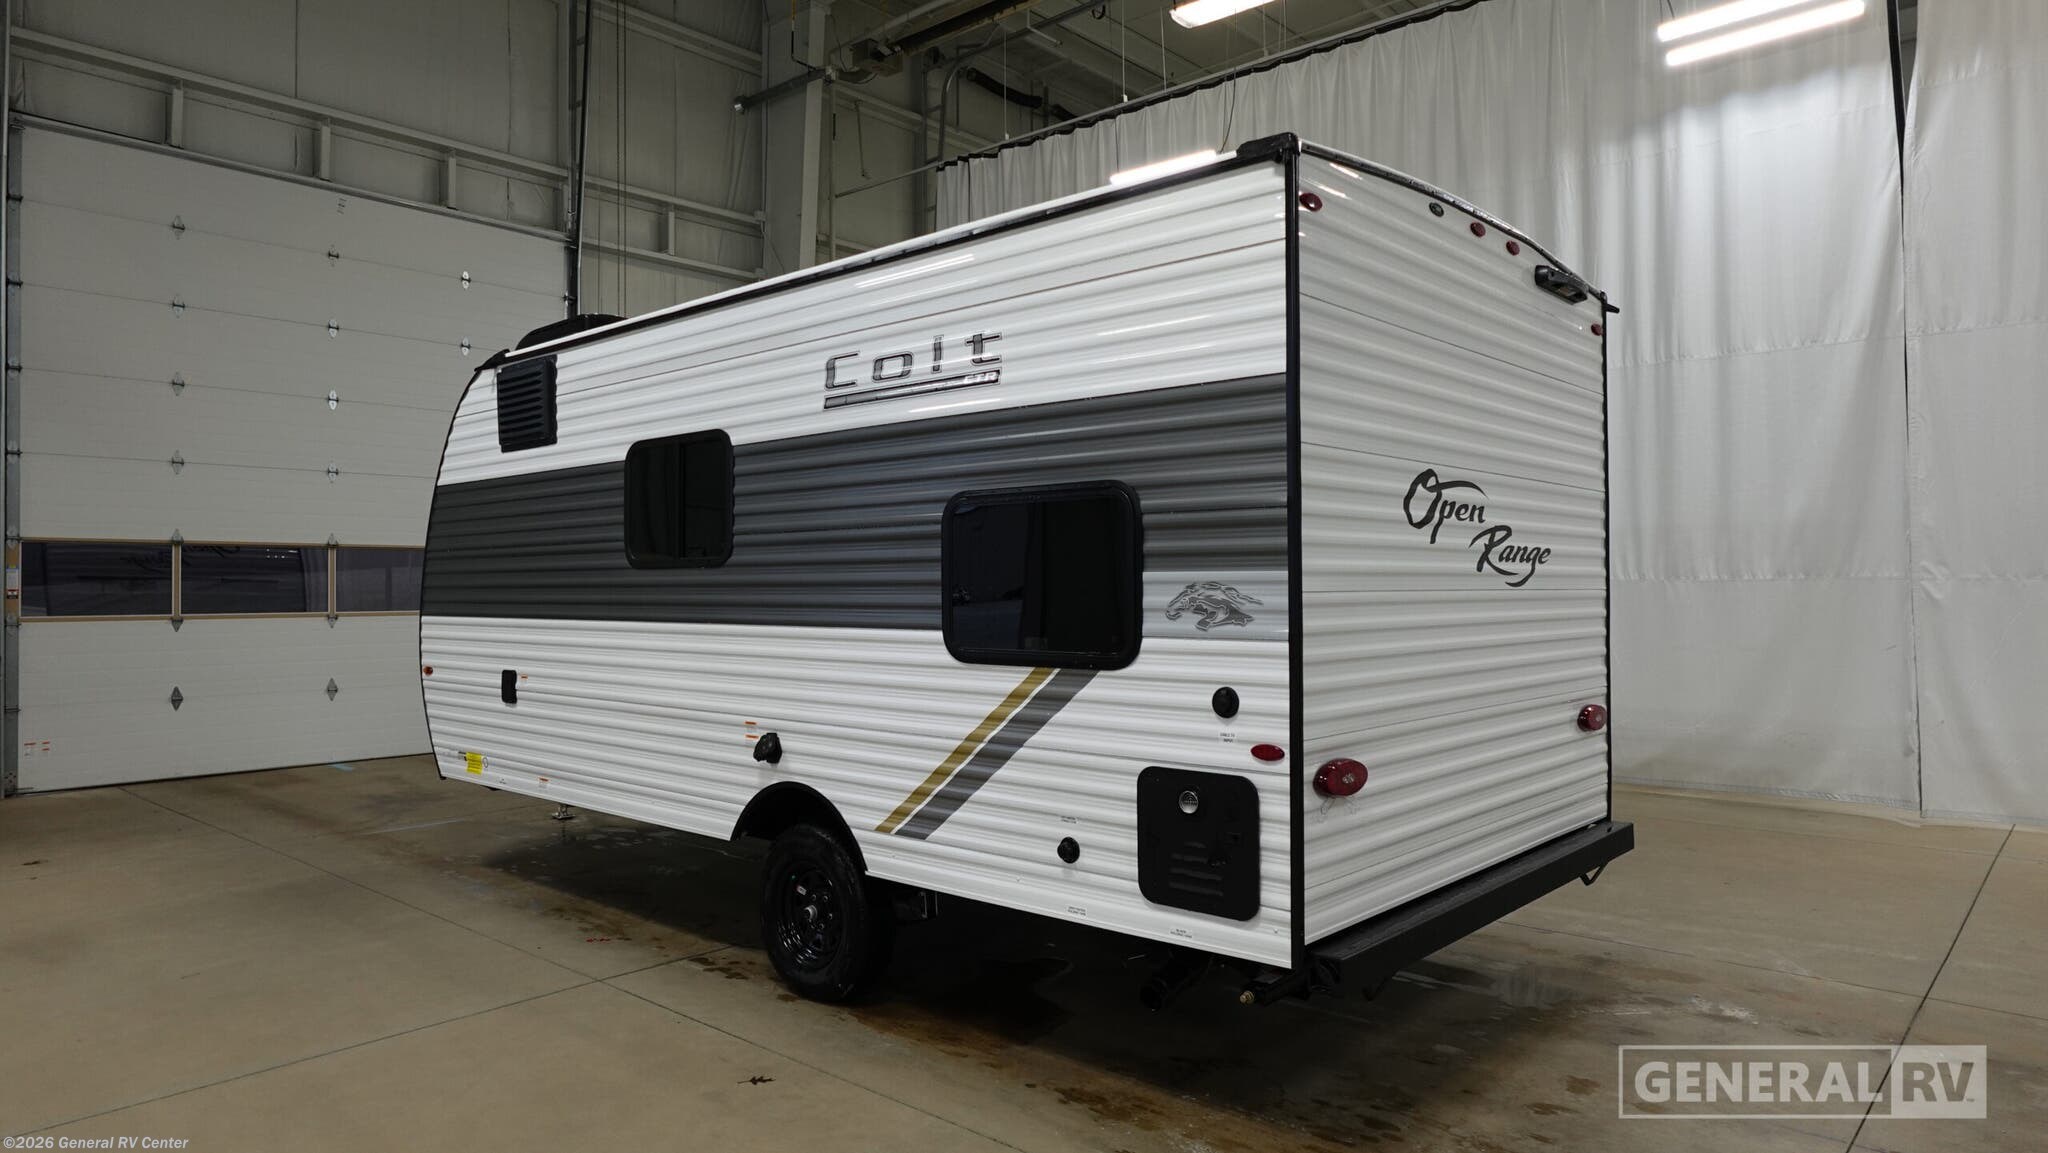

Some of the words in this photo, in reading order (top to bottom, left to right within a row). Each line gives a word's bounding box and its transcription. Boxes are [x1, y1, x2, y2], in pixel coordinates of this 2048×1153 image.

[825, 333, 1002, 389] Colt
[1403, 468, 1489, 544] Open
[1468, 524, 1552, 587] Range
